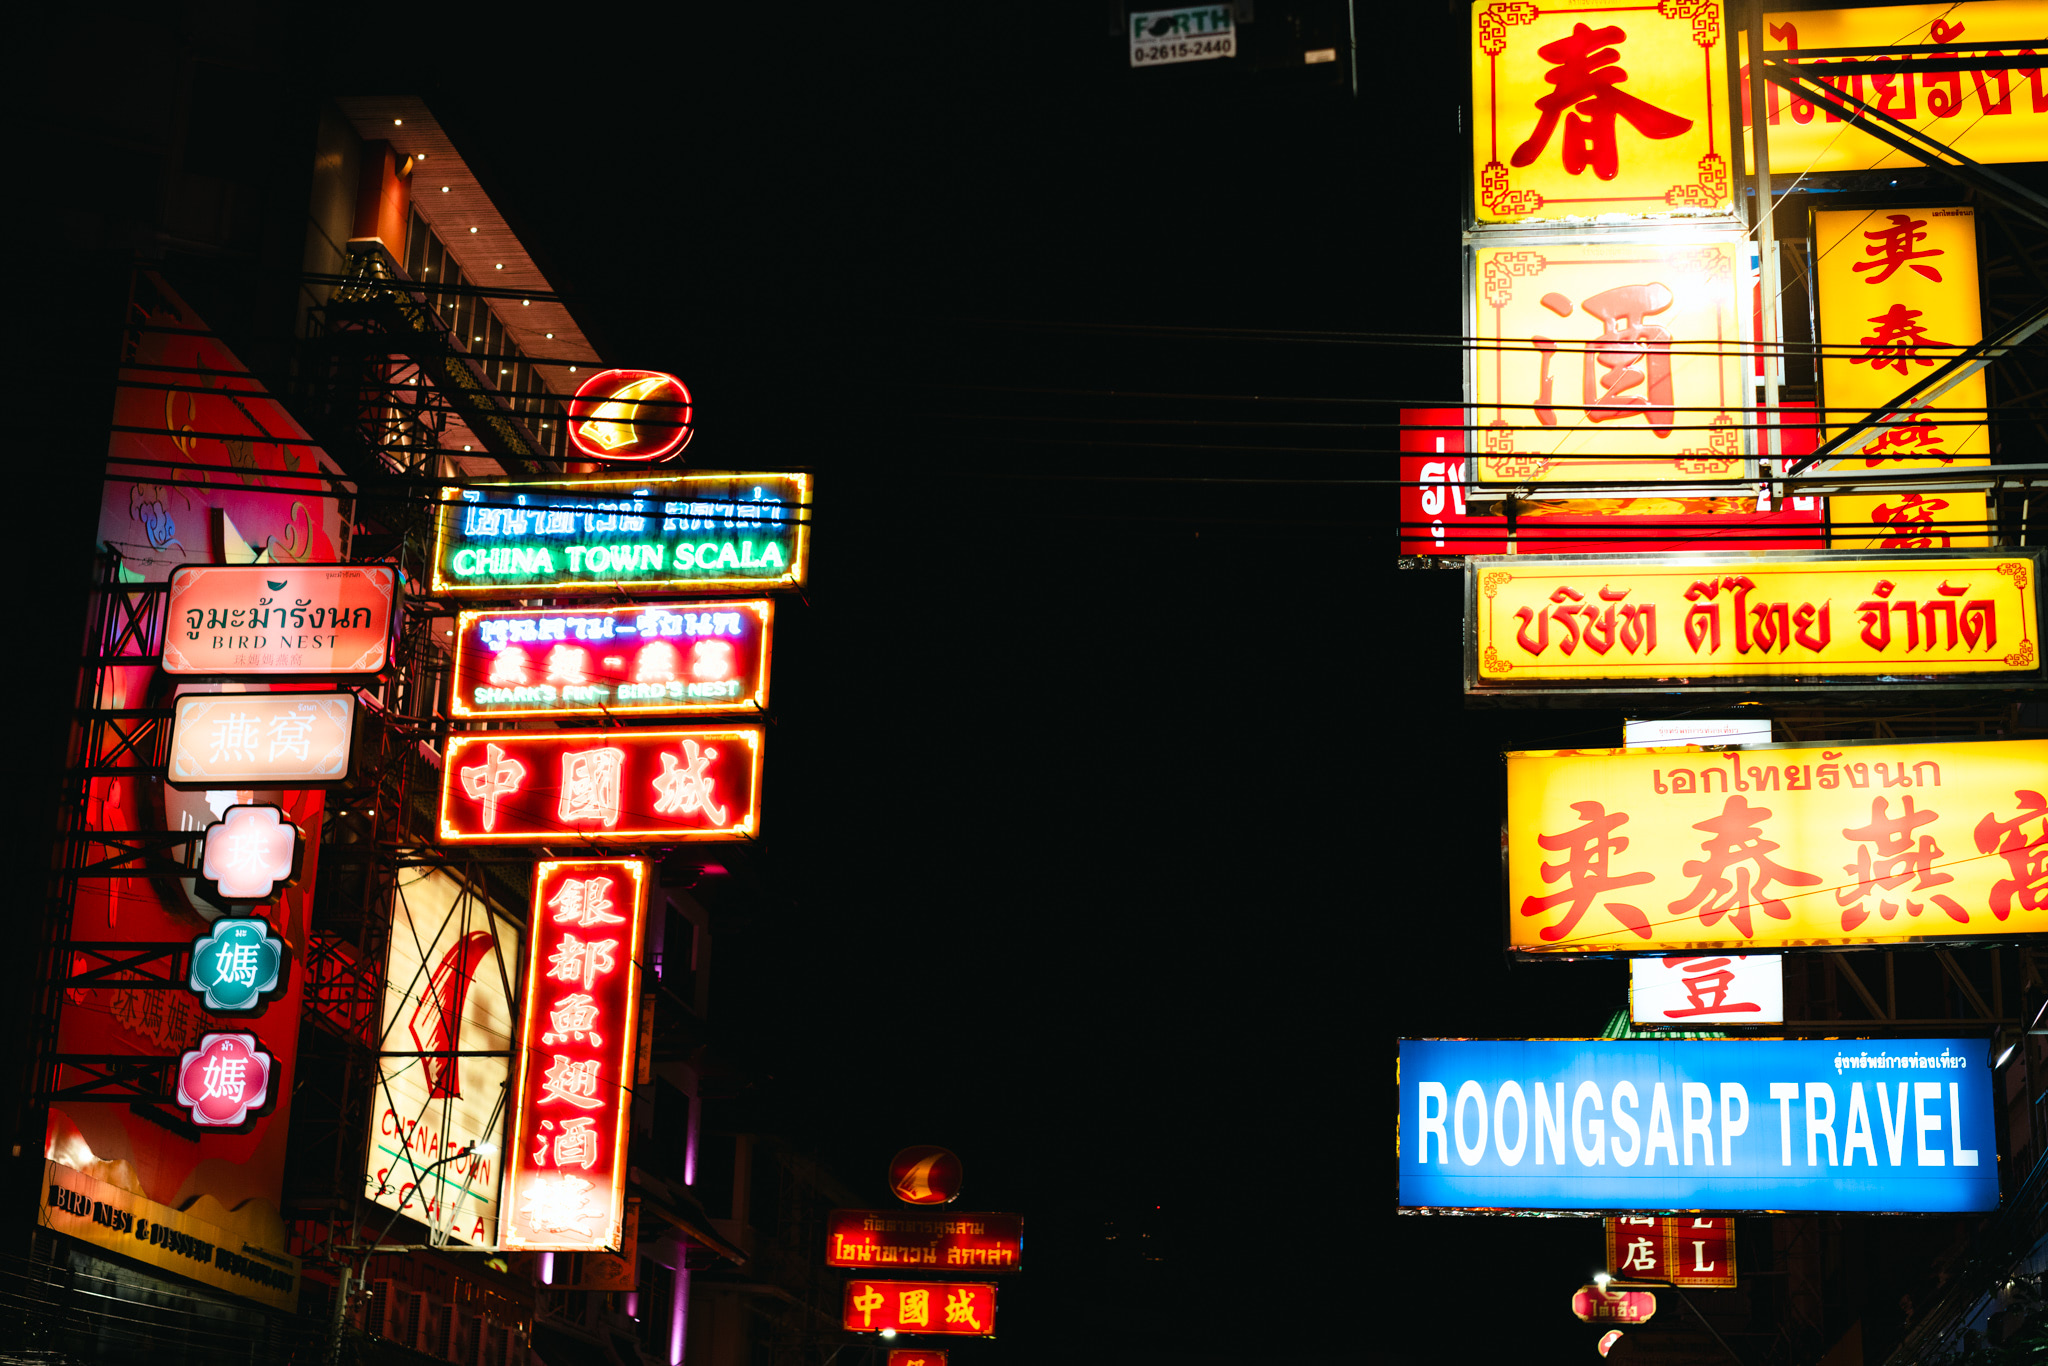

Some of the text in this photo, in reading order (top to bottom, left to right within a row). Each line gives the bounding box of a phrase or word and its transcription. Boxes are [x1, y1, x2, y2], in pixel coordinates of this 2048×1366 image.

[1135, 39, 1231, 62] 0-2615-2440
[1510, 22, 1694, 181] 春
[1531, 281, 1675, 439] 酒
[453, 541, 785, 577] CHINA TOWN SCALA
[186, 597, 372, 640] จูมะม้ารังนก
[1513, 575, 1998, 656] บริษัท ดีไทย จำกัด
[212, 634, 339, 649] BIRD NEST
[475, 685, 557, 704] SHARK'S
[618, 681, 683, 700] BIRD'S
[688, 680, 740, 697] NEST
[460, 738, 727, 832] 中國城
[1652, 751, 1943, 795] เอกไทยรังนก
[226, 829, 270, 875] 珠
[212, 942, 261, 988] 媽
[199, 1056, 249, 1104] 媽
[1834, 1047, 1967, 1075] รุ่งทรัพย์การท่องเที่ยว
[381, 1108, 439, 1159] CHINA
[1417, 1079, 1979, 1168] ROONGSARP TRAVEL
[56, 1184, 95, 1217] BIRD
[100, 1203, 137, 1235] NEST
[834, 1233, 1013, 1266] ไชน่าทาวน์ สกาล่า
[853, 1284, 981, 1331] 中國城
